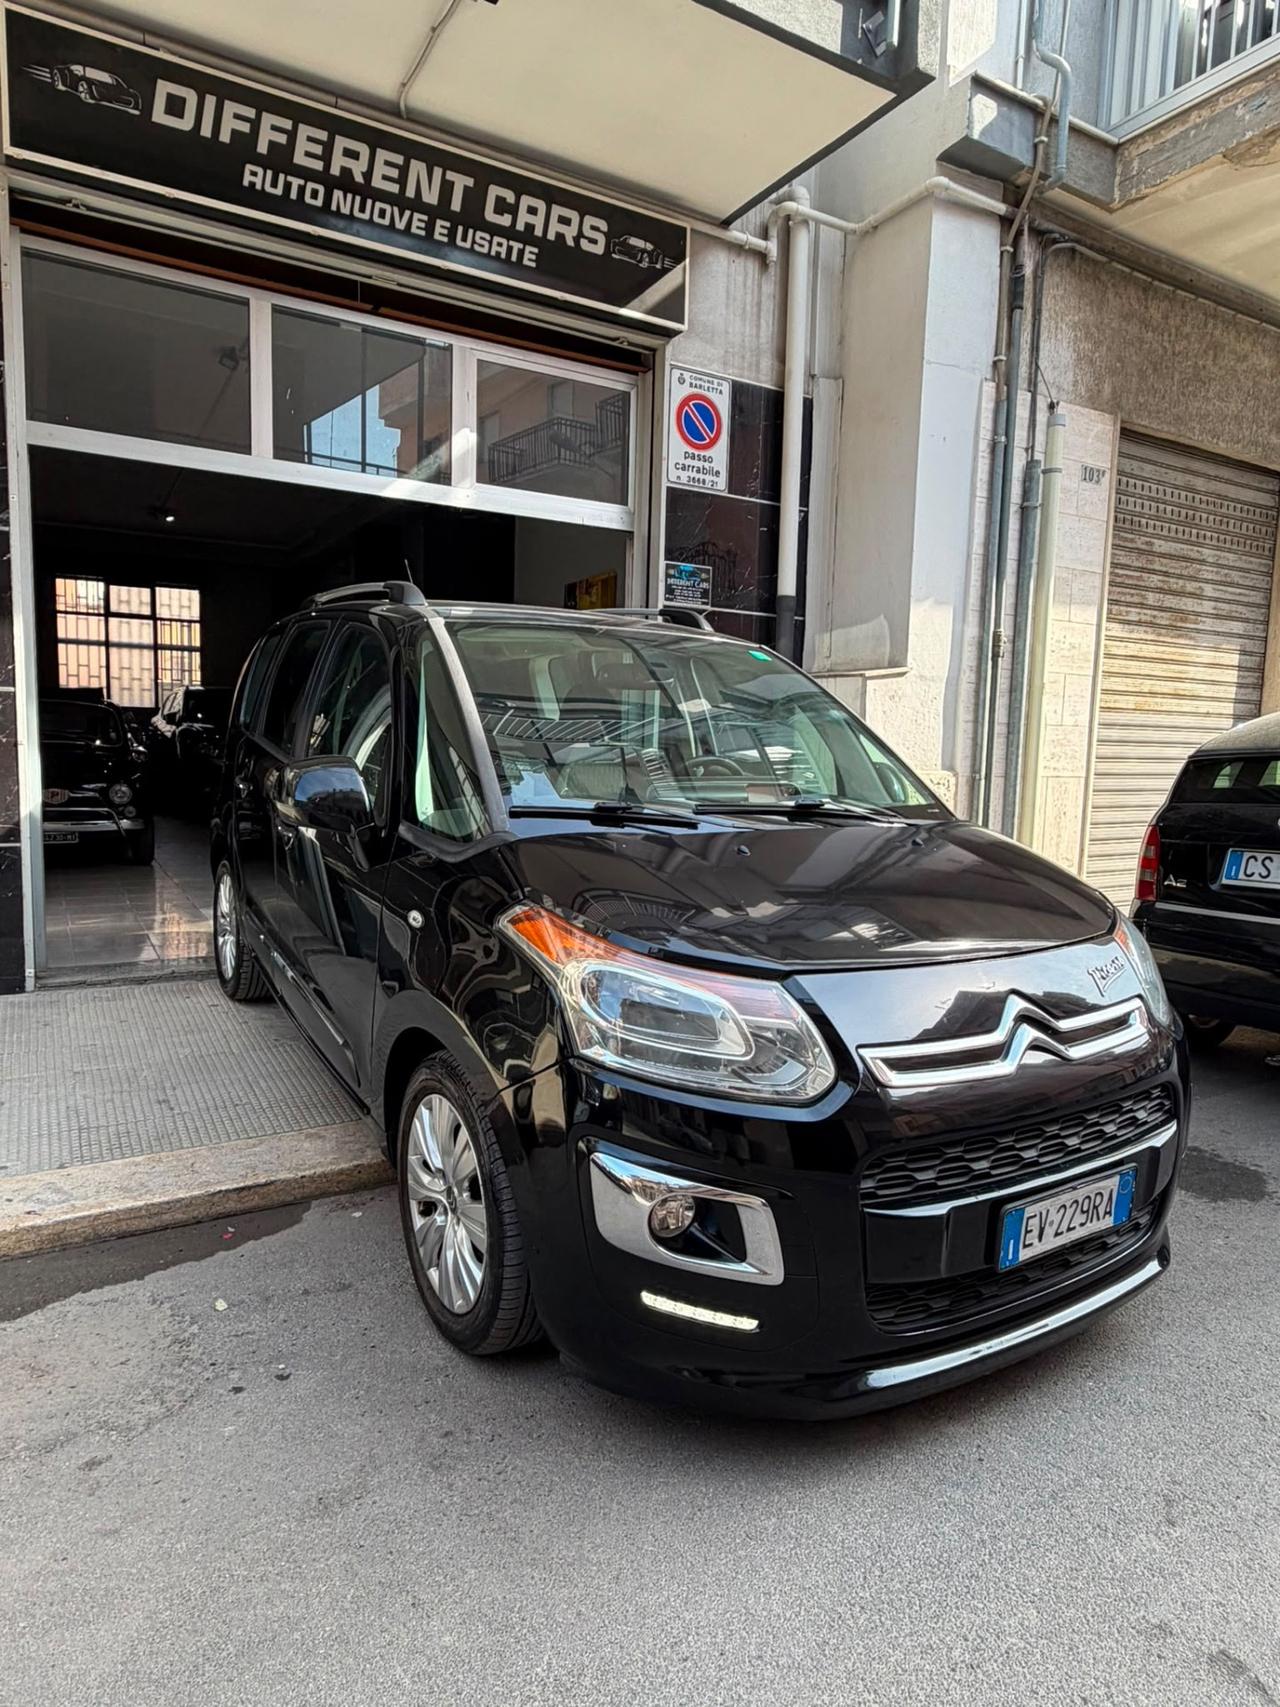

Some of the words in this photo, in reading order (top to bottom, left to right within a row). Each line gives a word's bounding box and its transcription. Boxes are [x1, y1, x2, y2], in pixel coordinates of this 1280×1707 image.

[151, 79, 474, 212] DIFFERENT
[484, 184, 608, 255] CARS
[242, 163, 325, 207] AUTO
[331, 189, 428, 236] NUOVE
[433, 219, 451, 243] E
[456, 225, 539, 268] USATE
[689, 374, 715, 386] COMUNE
[689, 382, 723, 395] BARLETTA
[684, 451, 714, 464] passo
[674, 462, 721, 478] carrabile
[1243, 855, 1274, 879] CS
